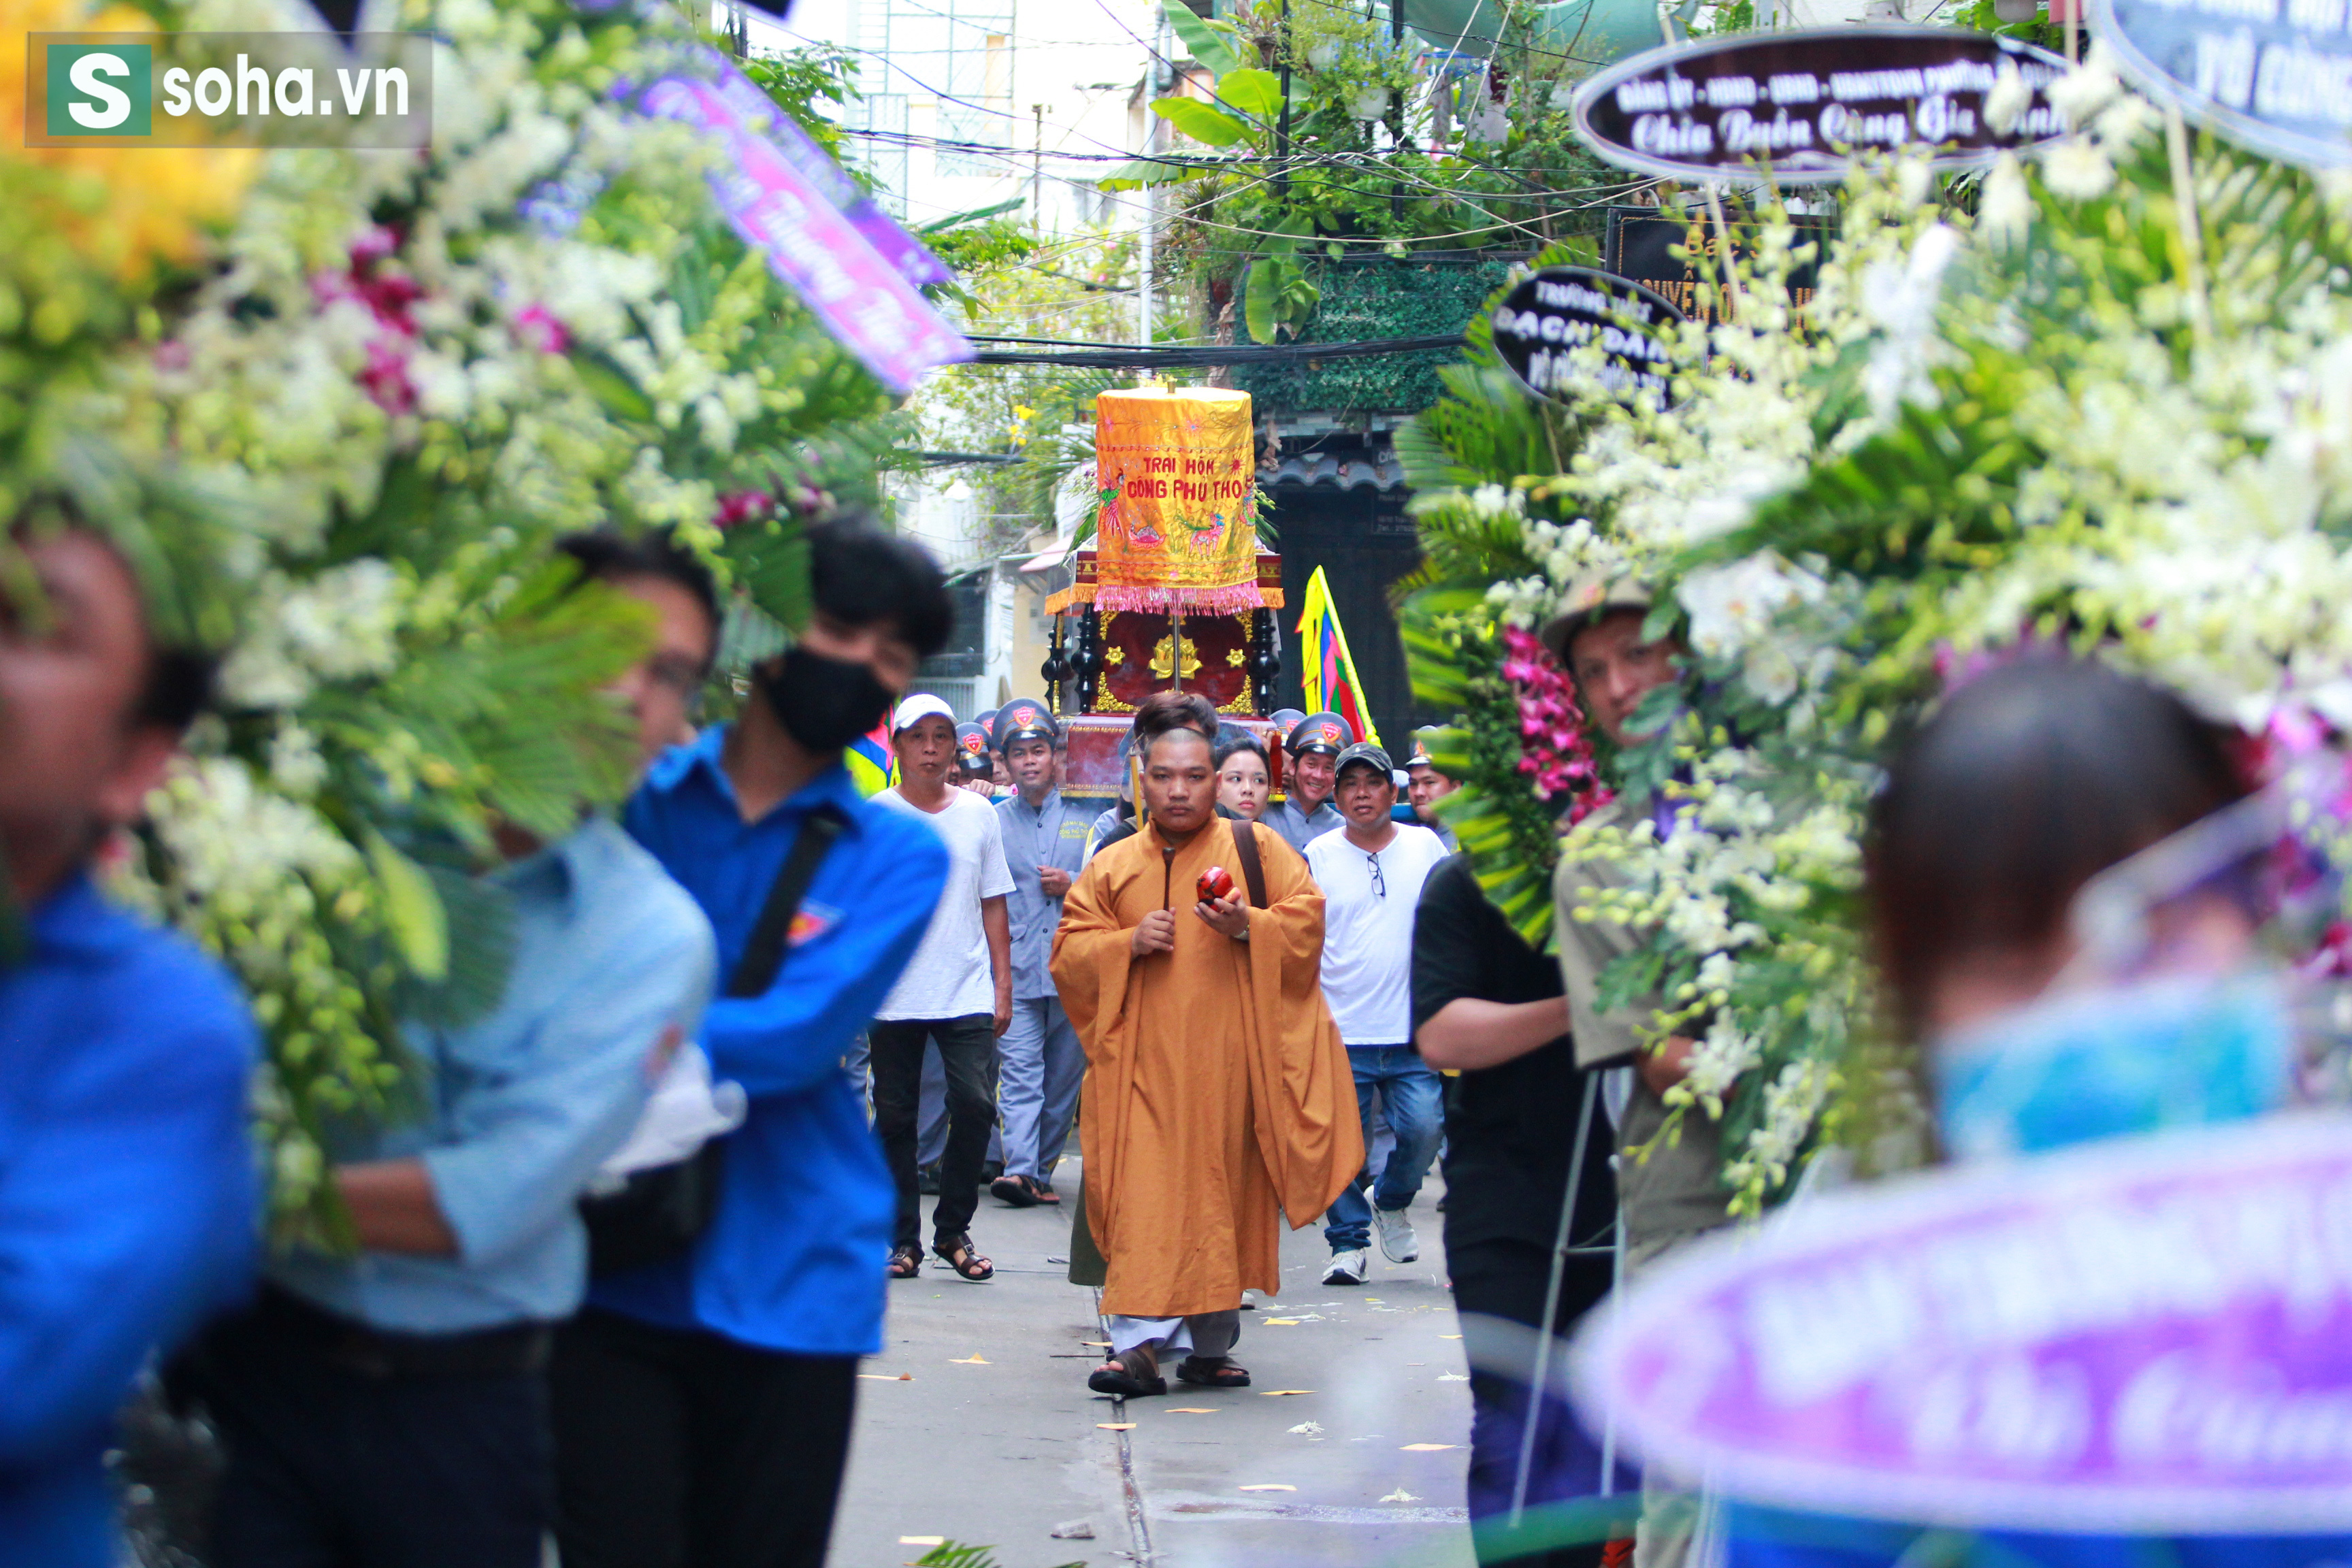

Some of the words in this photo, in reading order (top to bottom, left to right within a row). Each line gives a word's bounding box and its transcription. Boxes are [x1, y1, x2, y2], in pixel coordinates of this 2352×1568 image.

[1144, 457, 1176, 476] TRẠI
[1128, 476, 1167, 498] CÔNG
[1174, 476, 1208, 502] PHÚ
[1213, 480, 1243, 505] THỌ
